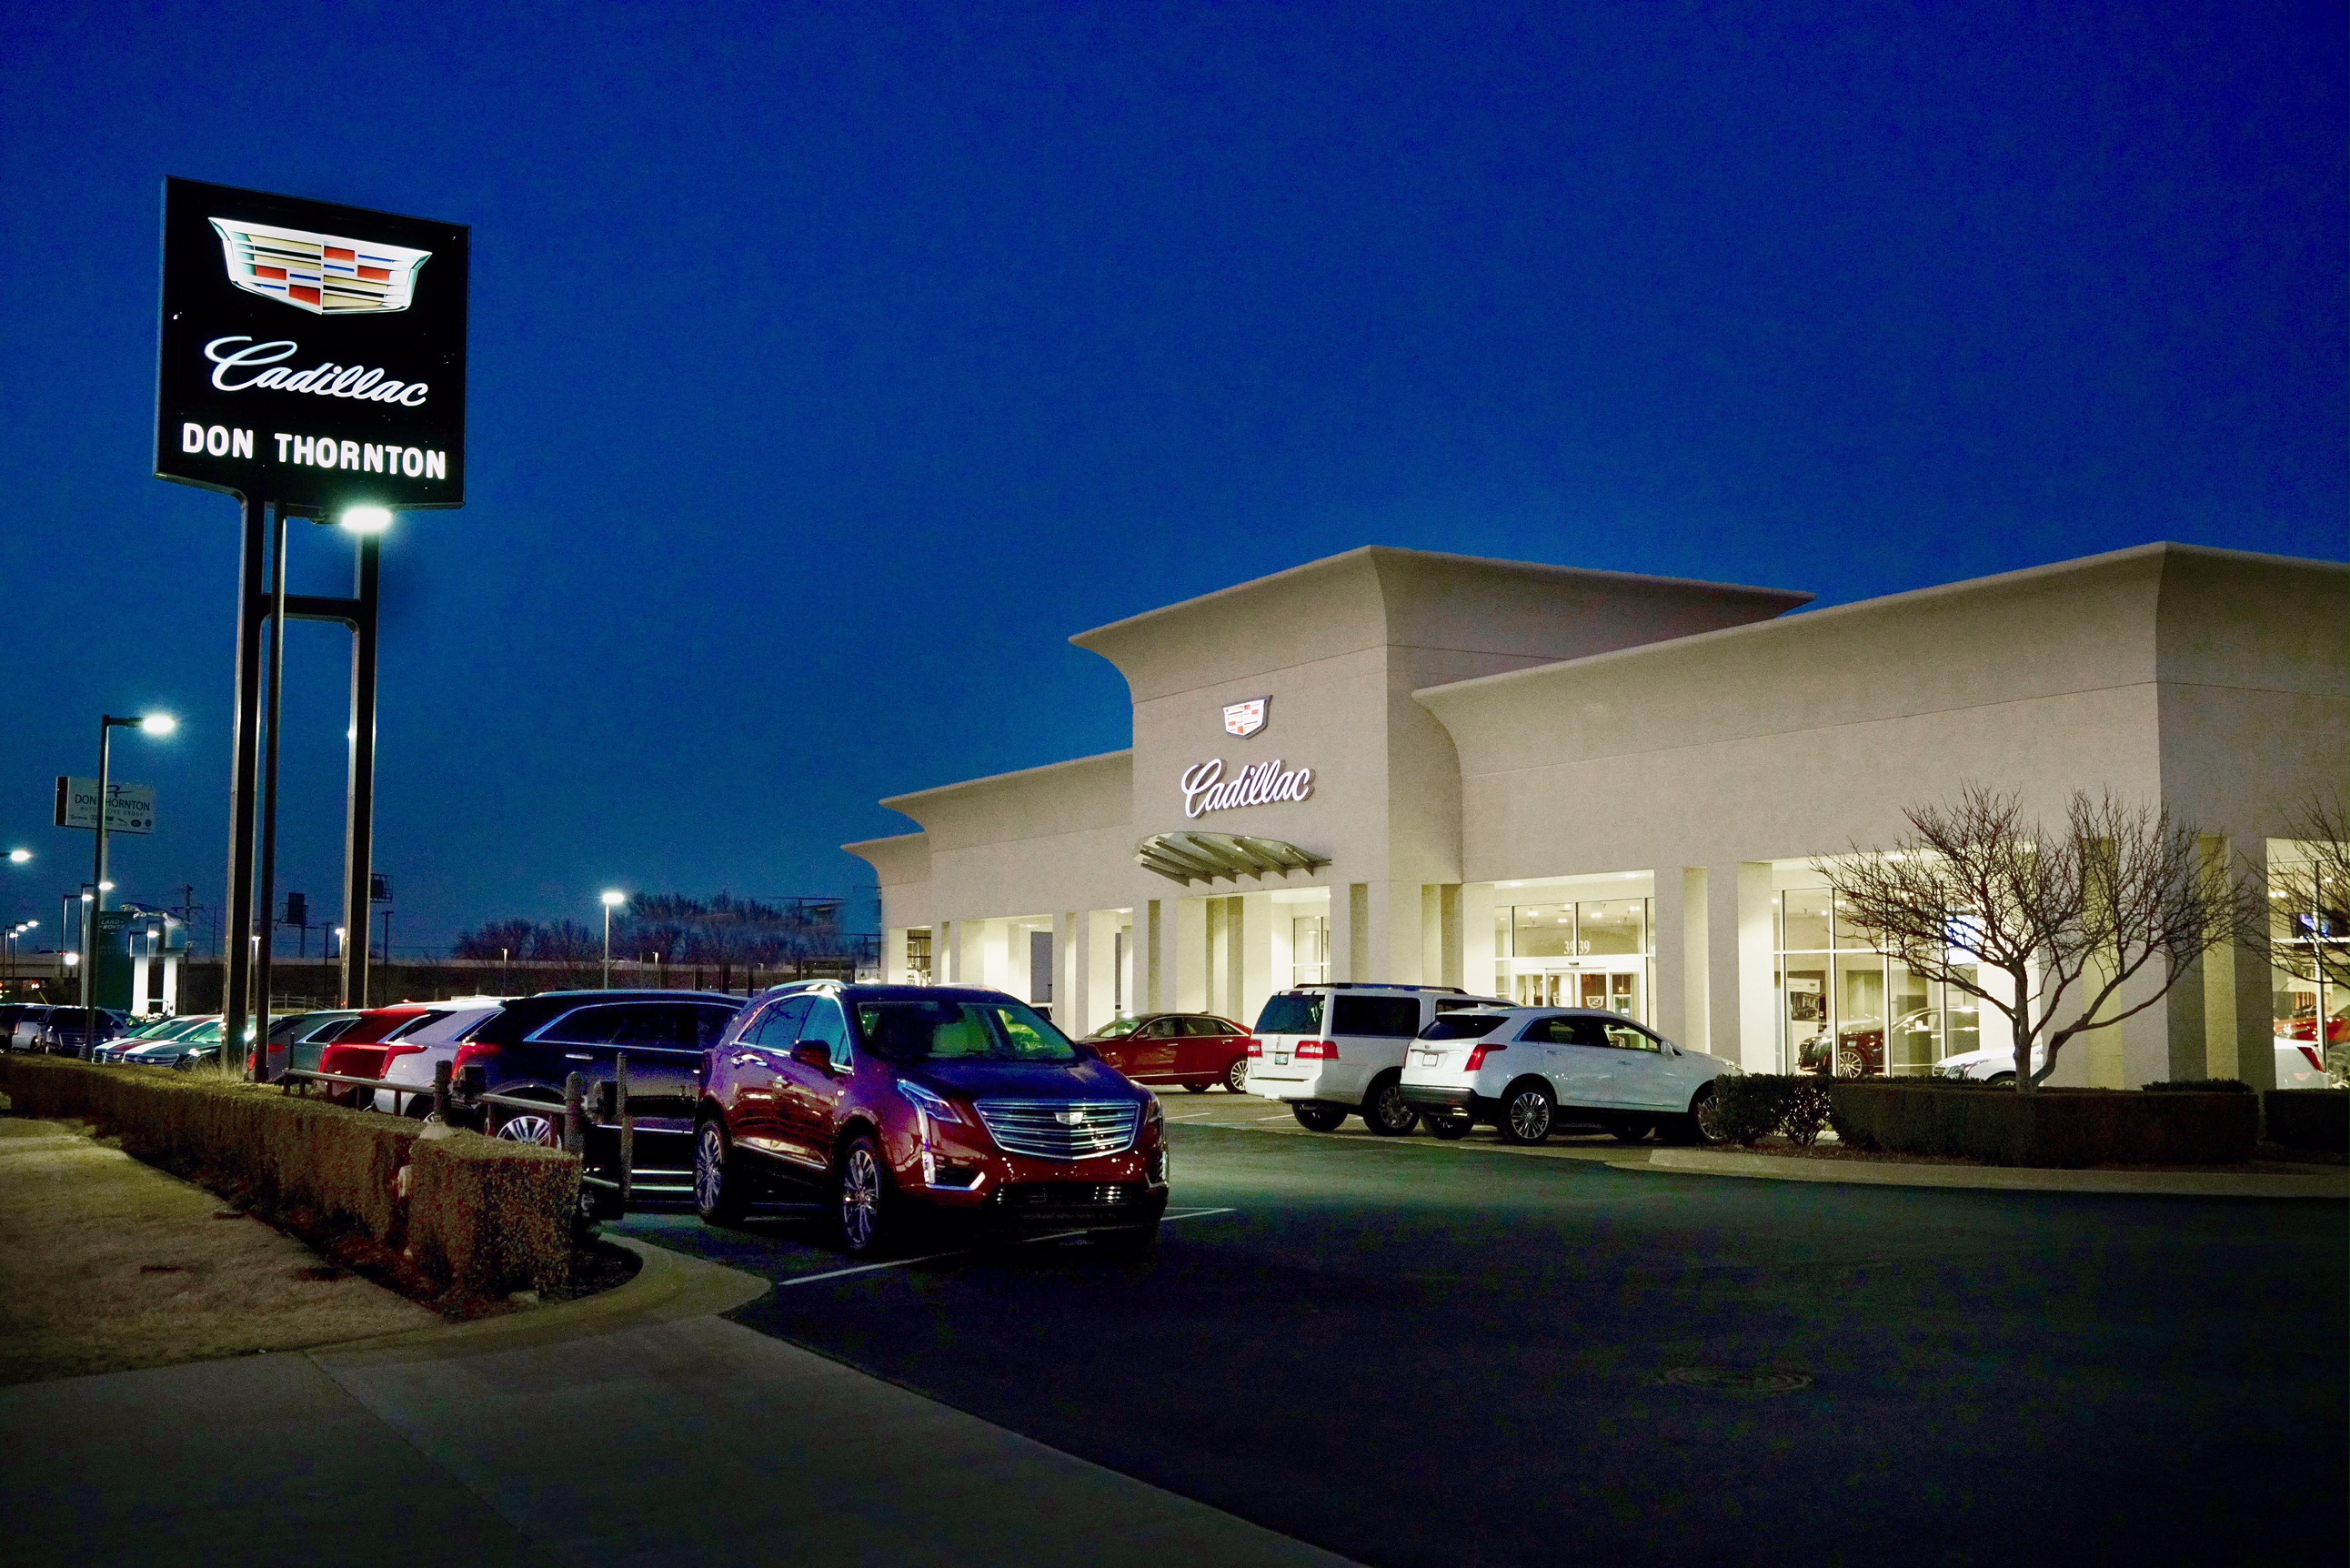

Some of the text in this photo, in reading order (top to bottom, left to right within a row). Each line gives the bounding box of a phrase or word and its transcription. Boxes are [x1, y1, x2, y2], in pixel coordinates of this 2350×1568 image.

[205, 336, 429, 407] Cadillac
[182, 422, 446, 480] DON THORNTON
[75, 794, 150, 811] DON HORNTON
[1180, 759, 1313, 819] Cadillac
